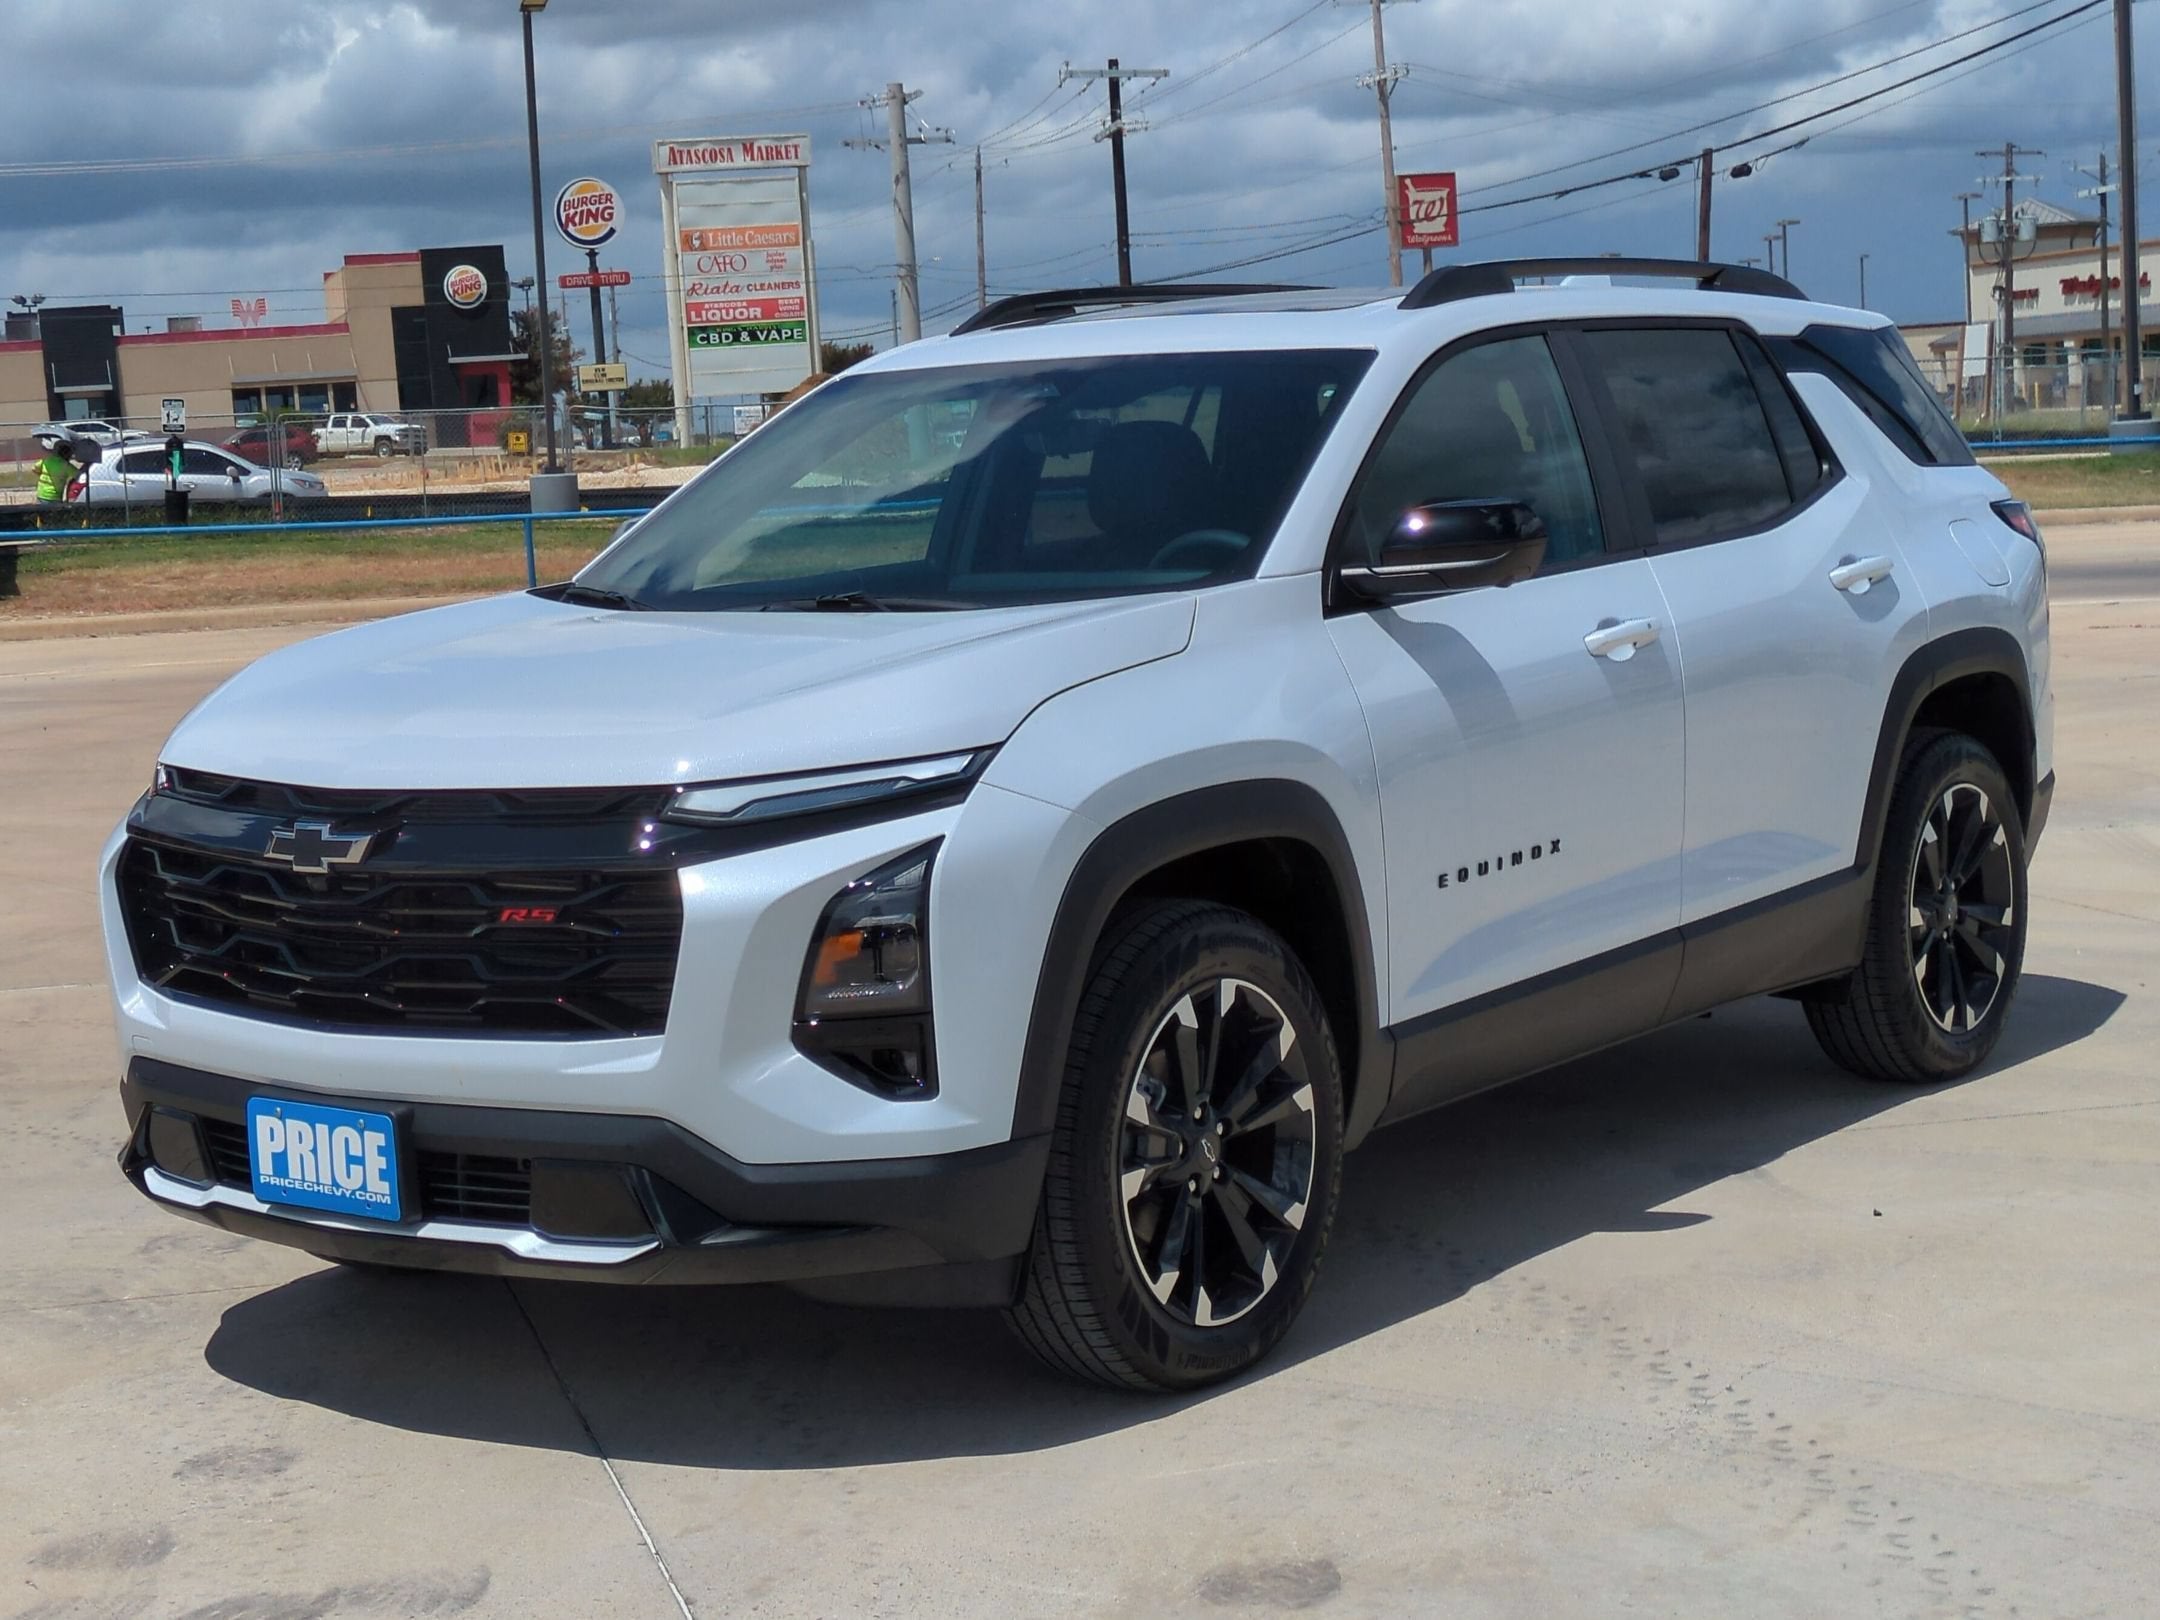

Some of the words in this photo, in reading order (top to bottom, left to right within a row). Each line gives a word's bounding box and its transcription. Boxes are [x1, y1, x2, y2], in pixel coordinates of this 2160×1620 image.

[563, 193, 613, 212] BURGER
[563, 205, 614, 230] KING
[708, 231, 743, 247] Little
[745, 230, 796, 245] Caesars
[450, 273, 480, 288] BURGER
[566, 276, 594, 285] DRIVE
[601, 274, 626, 284] THRU
[452, 281, 481, 298] KING
[687, 281, 742, 296] Riata
[746, 281, 801, 292] CLEANERS
[690, 307, 762, 322] LIQUOR
[696, 332, 733, 345] CBD
[740, 331, 751, 342] &
[758, 328, 803, 341] VAPE
[1438, 838, 1561, 889] EQUINOX
[501, 907, 556, 922] RS
[256, 1114, 390, 1195] PRICE
[260, 1175, 392, 1205] PRICECHEVY.COM
